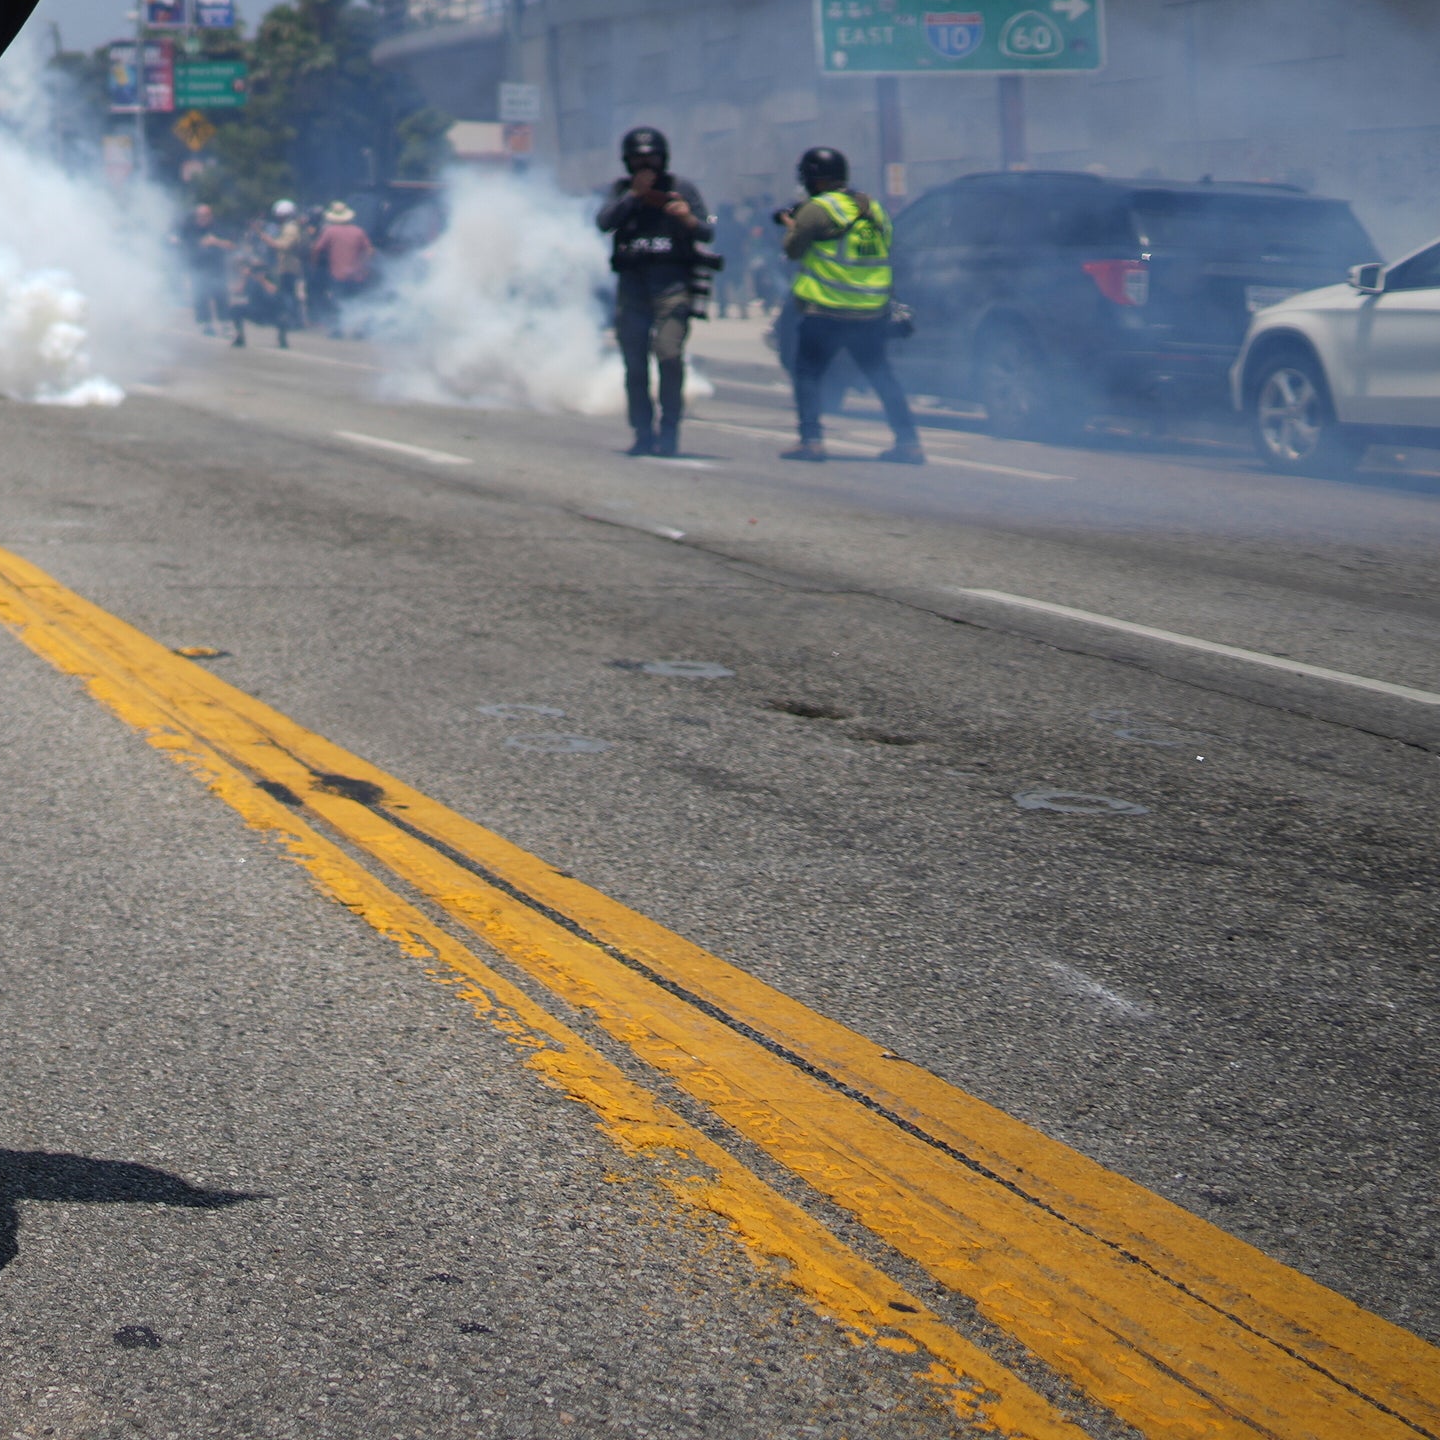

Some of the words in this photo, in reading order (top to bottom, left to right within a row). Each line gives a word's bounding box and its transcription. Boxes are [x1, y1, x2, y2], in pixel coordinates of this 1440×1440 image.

[839, 28, 895, 44] EAST
[938, 25, 970, 50] 10
[1013, 27, 1051, 49] 60
